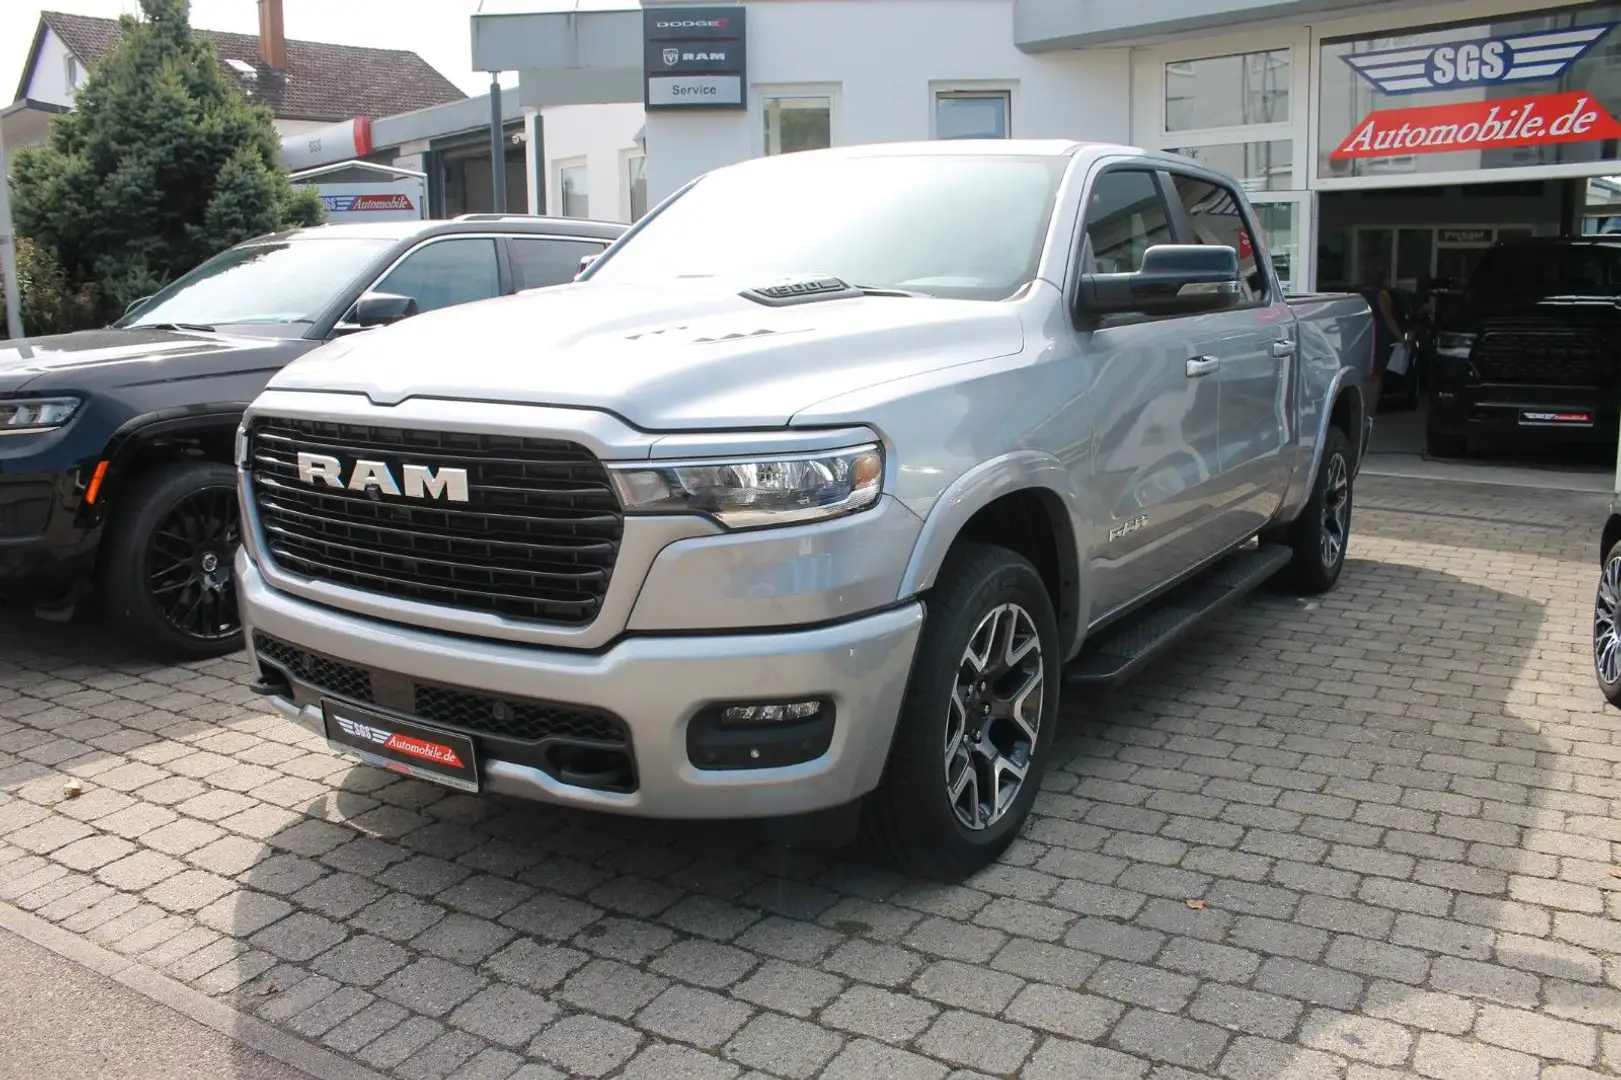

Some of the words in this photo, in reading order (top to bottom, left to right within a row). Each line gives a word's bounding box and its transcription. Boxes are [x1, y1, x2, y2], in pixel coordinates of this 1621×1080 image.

[657, 20, 721, 28] DODGE
[682, 52, 725, 60] RAM
[1433, 41, 1505, 84] SGS
[672, 85, 717, 95] Service
[1343, 97, 1598, 152] Automobile.de
[352, 195, 408, 210] Automobile
[297, 451, 469, 502] RAM
[353, 721, 372, 740] SGS
[388, 736, 456, 762] Automobile.de
